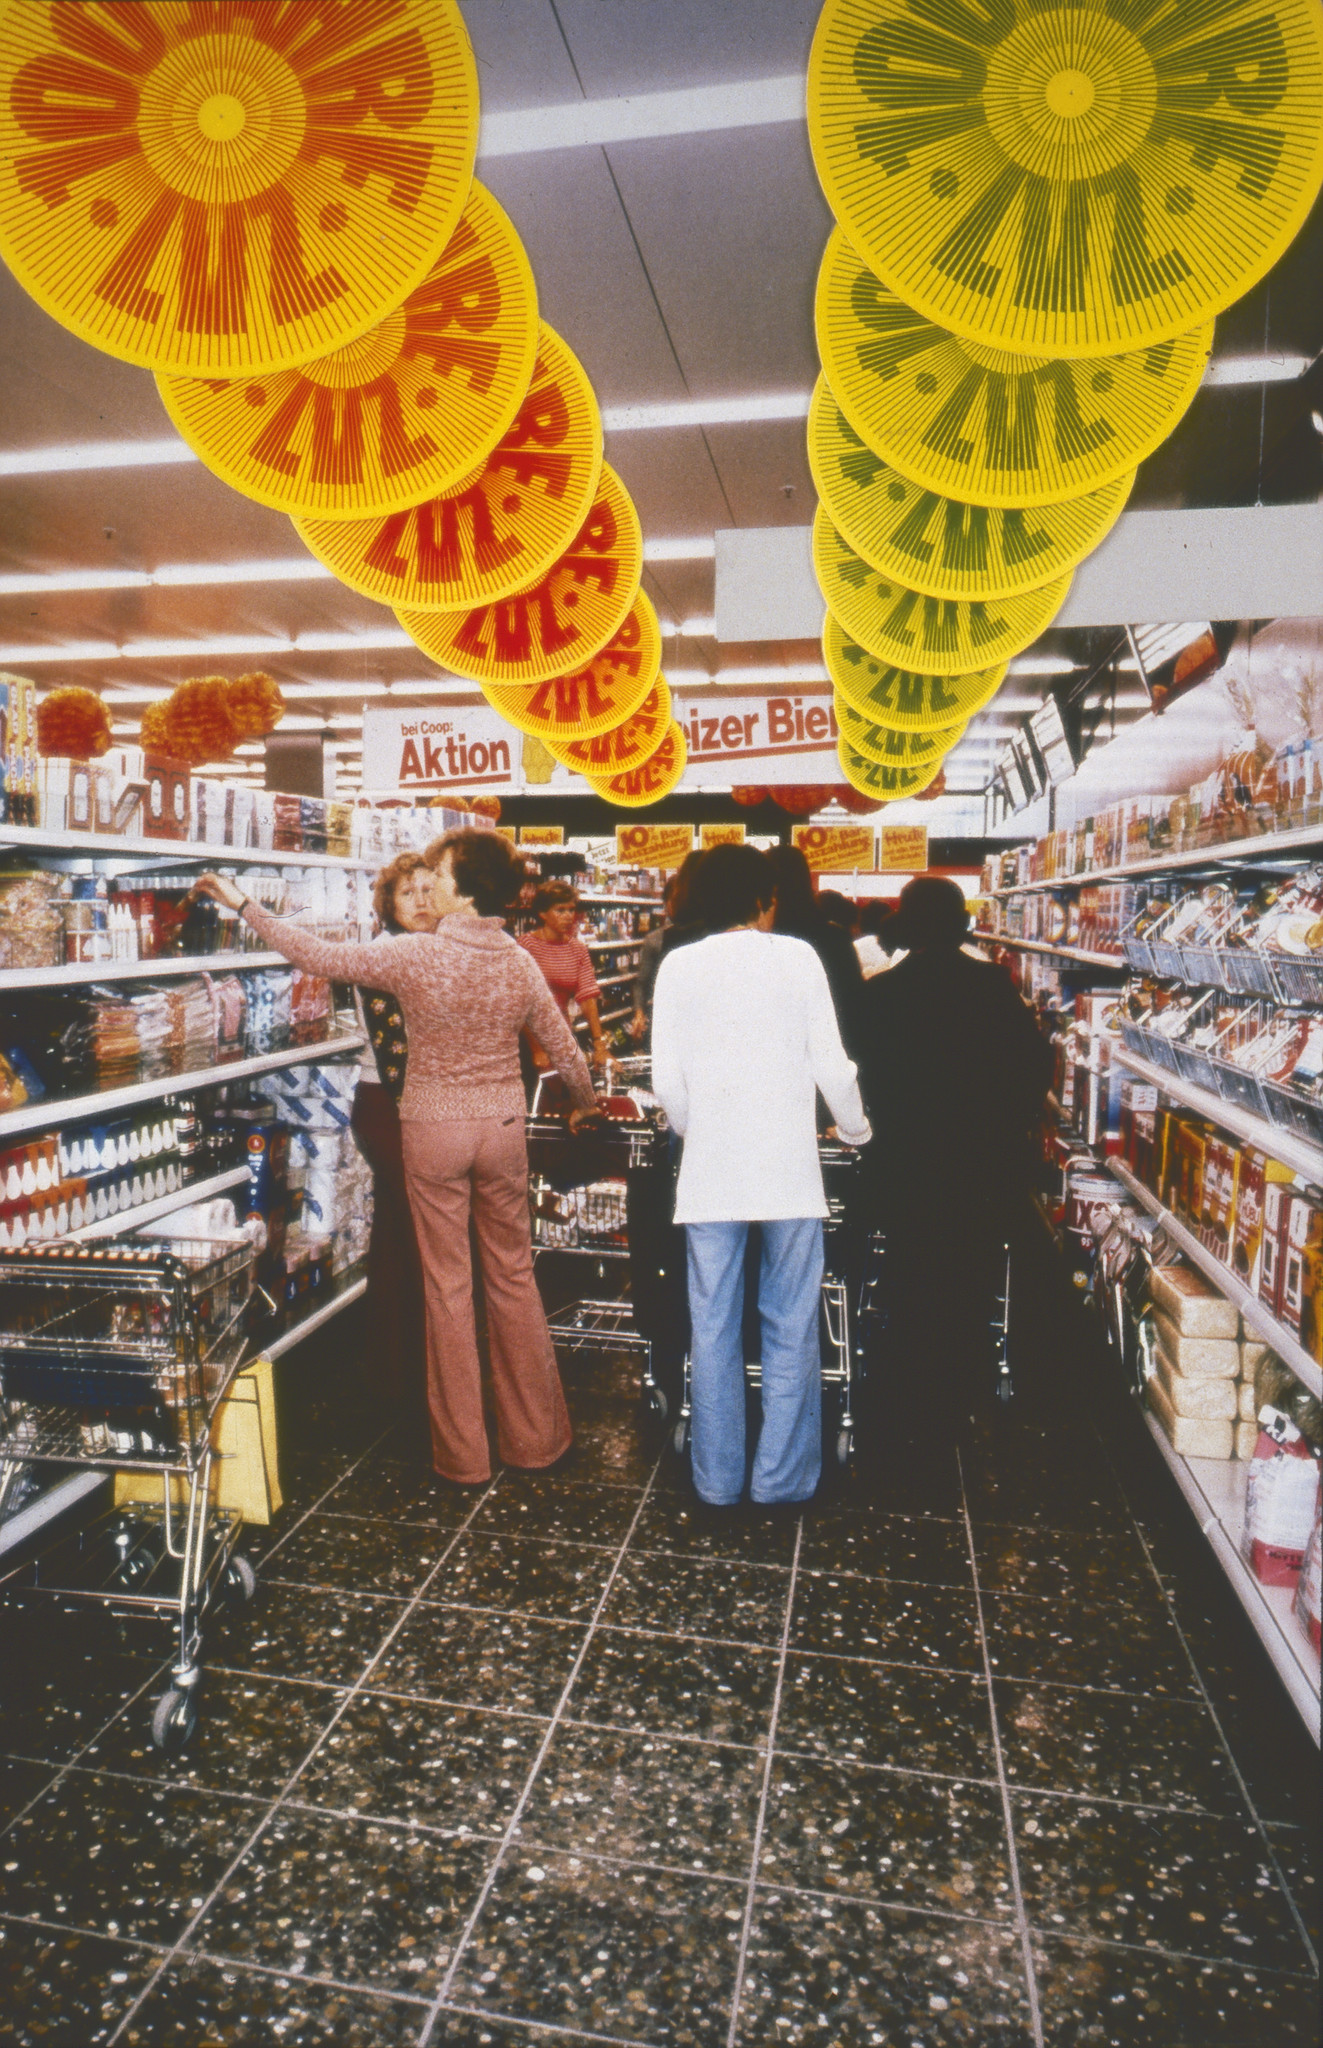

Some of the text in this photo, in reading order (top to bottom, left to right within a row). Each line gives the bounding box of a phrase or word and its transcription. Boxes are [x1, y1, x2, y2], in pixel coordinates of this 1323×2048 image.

[400, 720, 454, 737] bei Coop:
[399, 733, 511, 781] Aktion
